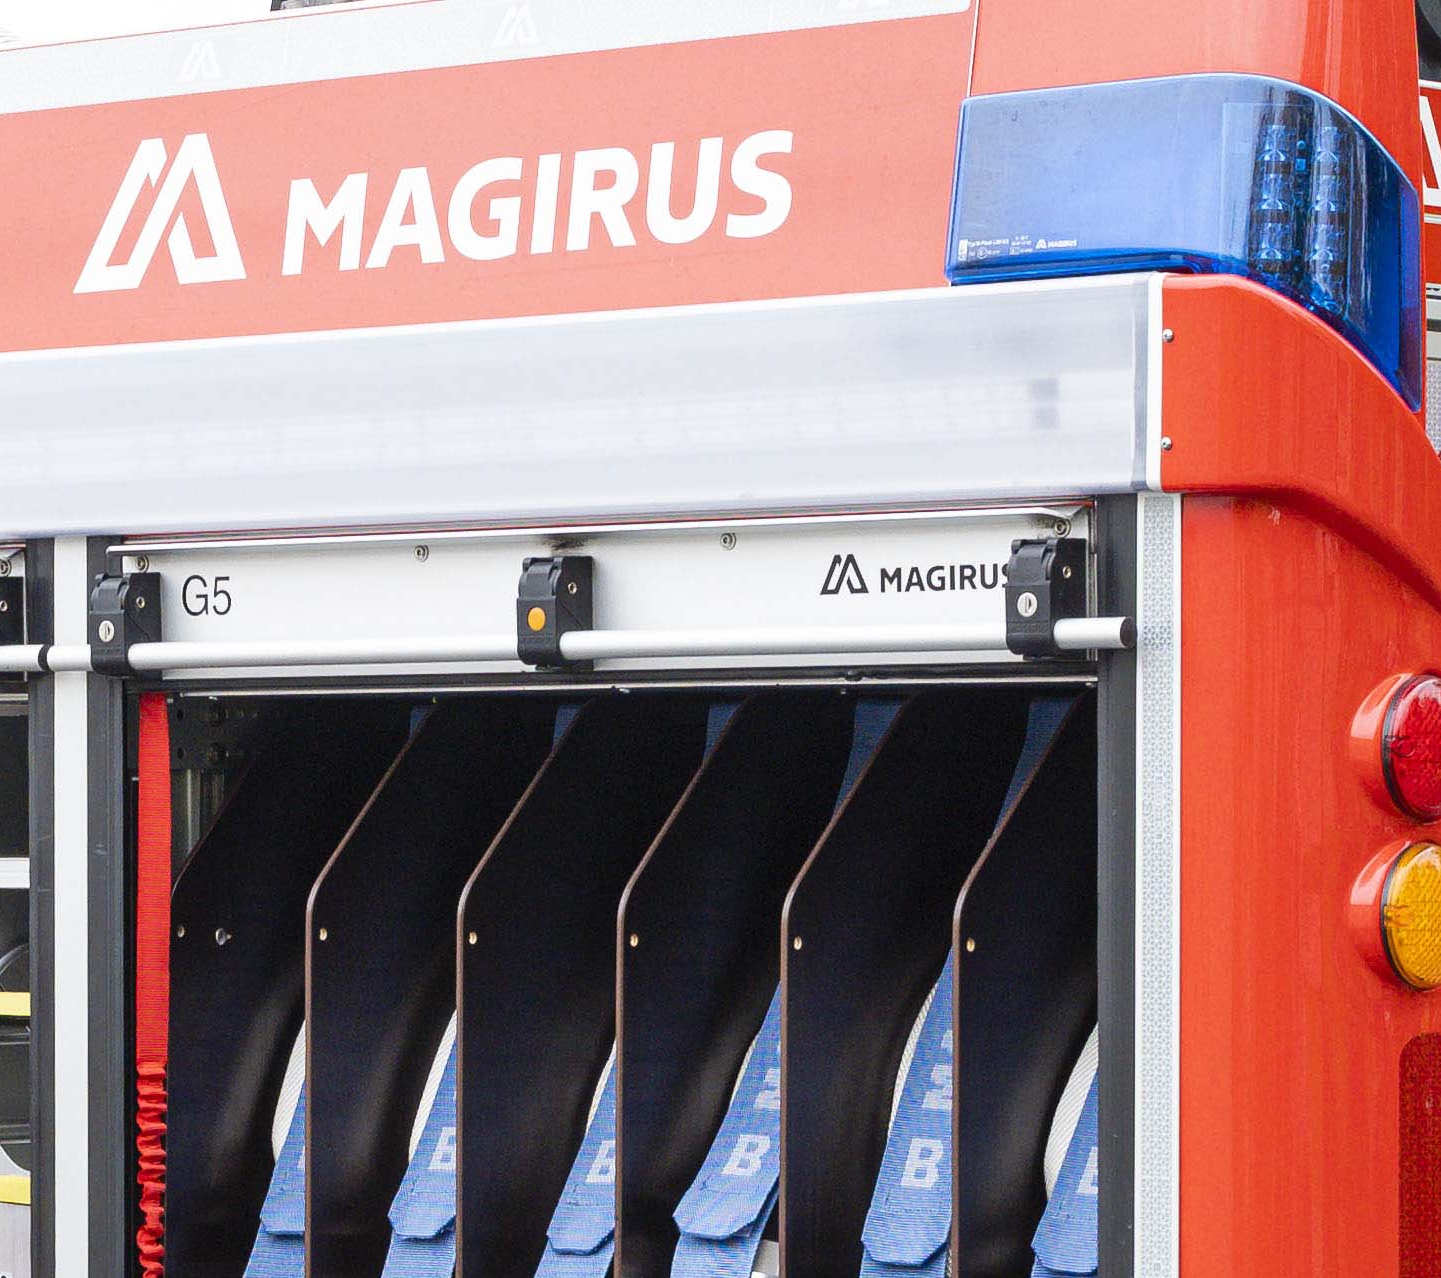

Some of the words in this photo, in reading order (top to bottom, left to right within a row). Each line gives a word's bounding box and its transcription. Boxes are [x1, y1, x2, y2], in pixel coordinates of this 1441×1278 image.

[279, 129, 794, 276] MAGIRUS
[182, 573, 232, 619] G5
[722, 1135, 770, 1176] B
[900, 1138, 944, 1187] B
